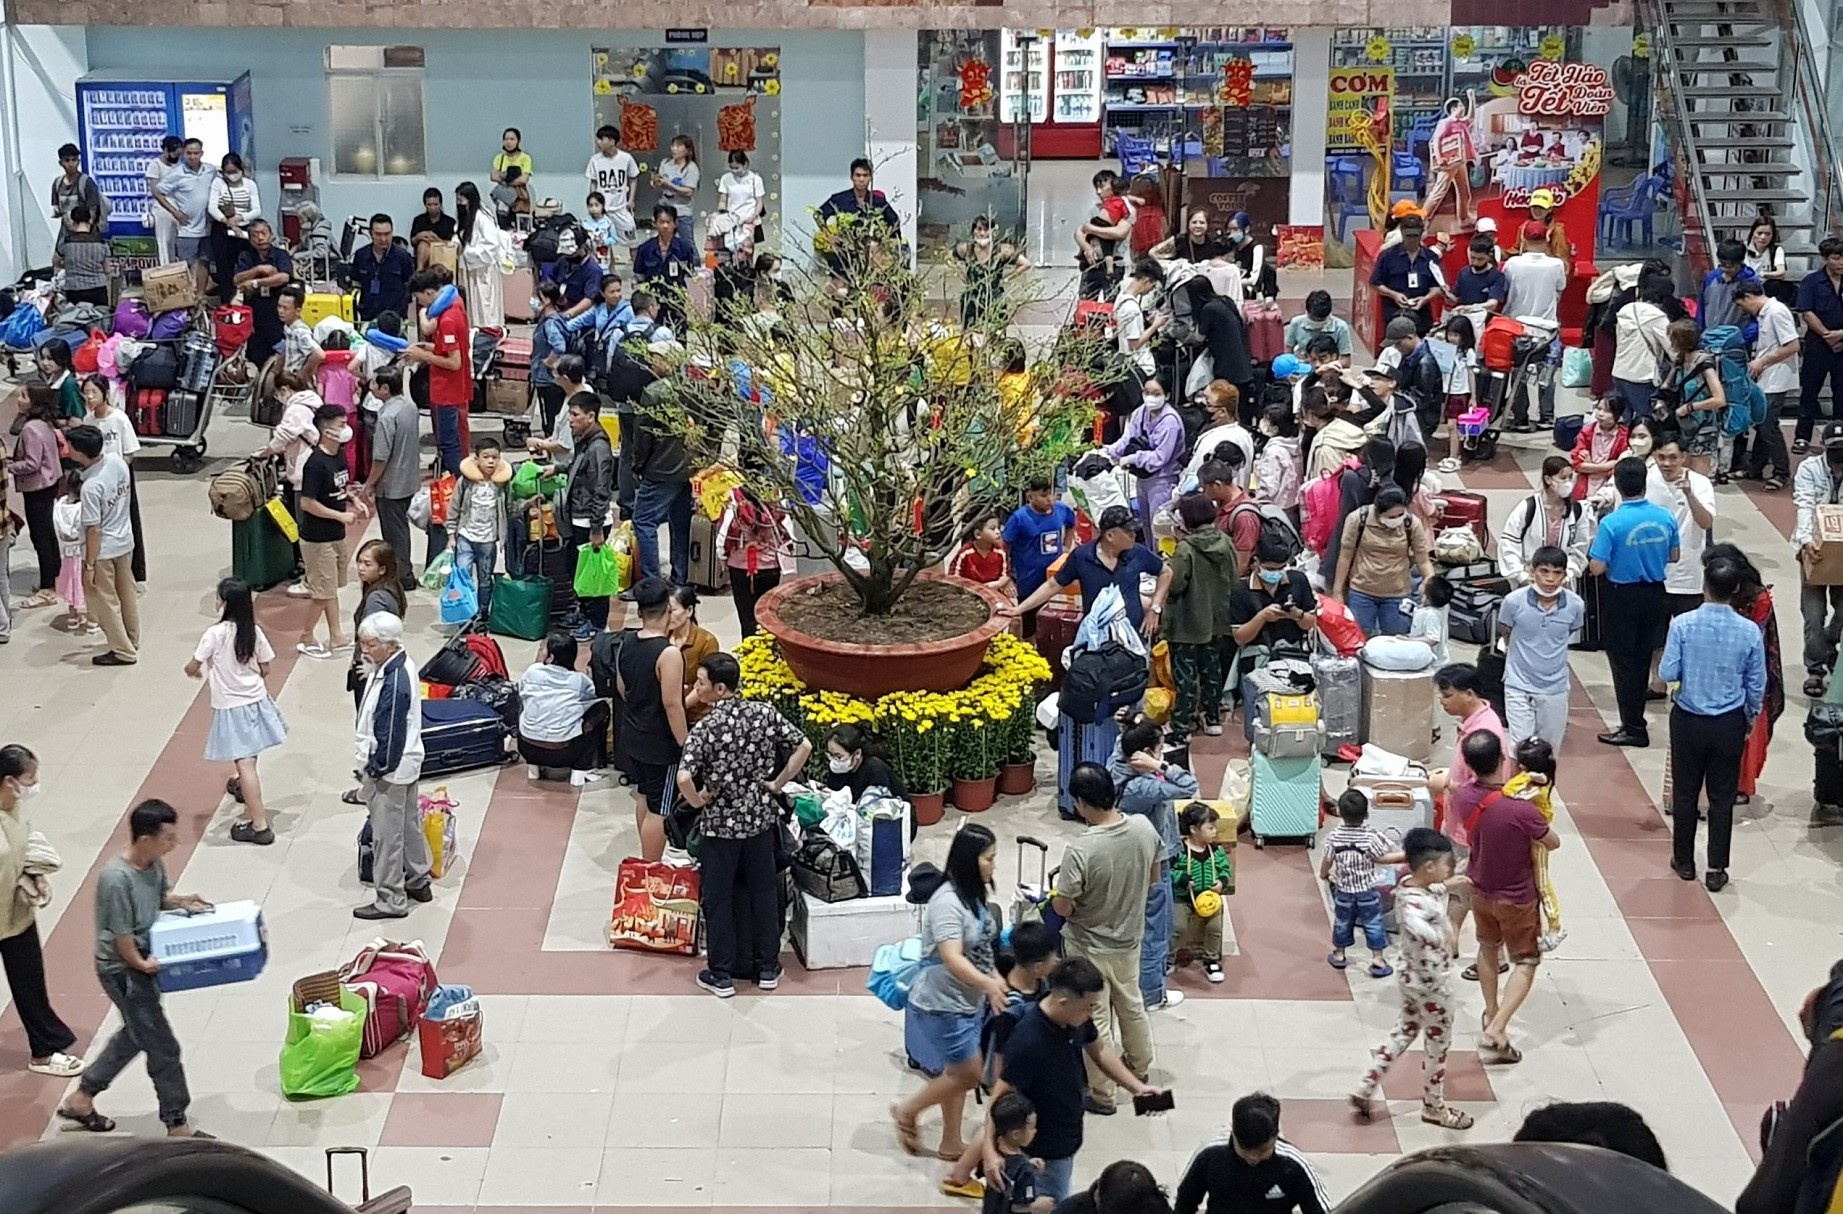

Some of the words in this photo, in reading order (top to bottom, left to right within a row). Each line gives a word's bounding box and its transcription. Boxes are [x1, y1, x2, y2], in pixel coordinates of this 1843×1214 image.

[1330, 72, 1389, 93] CƠM
[1521, 86, 1569, 113] Tết
[1573, 101, 1607, 113] Viên
[599, 169, 625, 188] BAD
